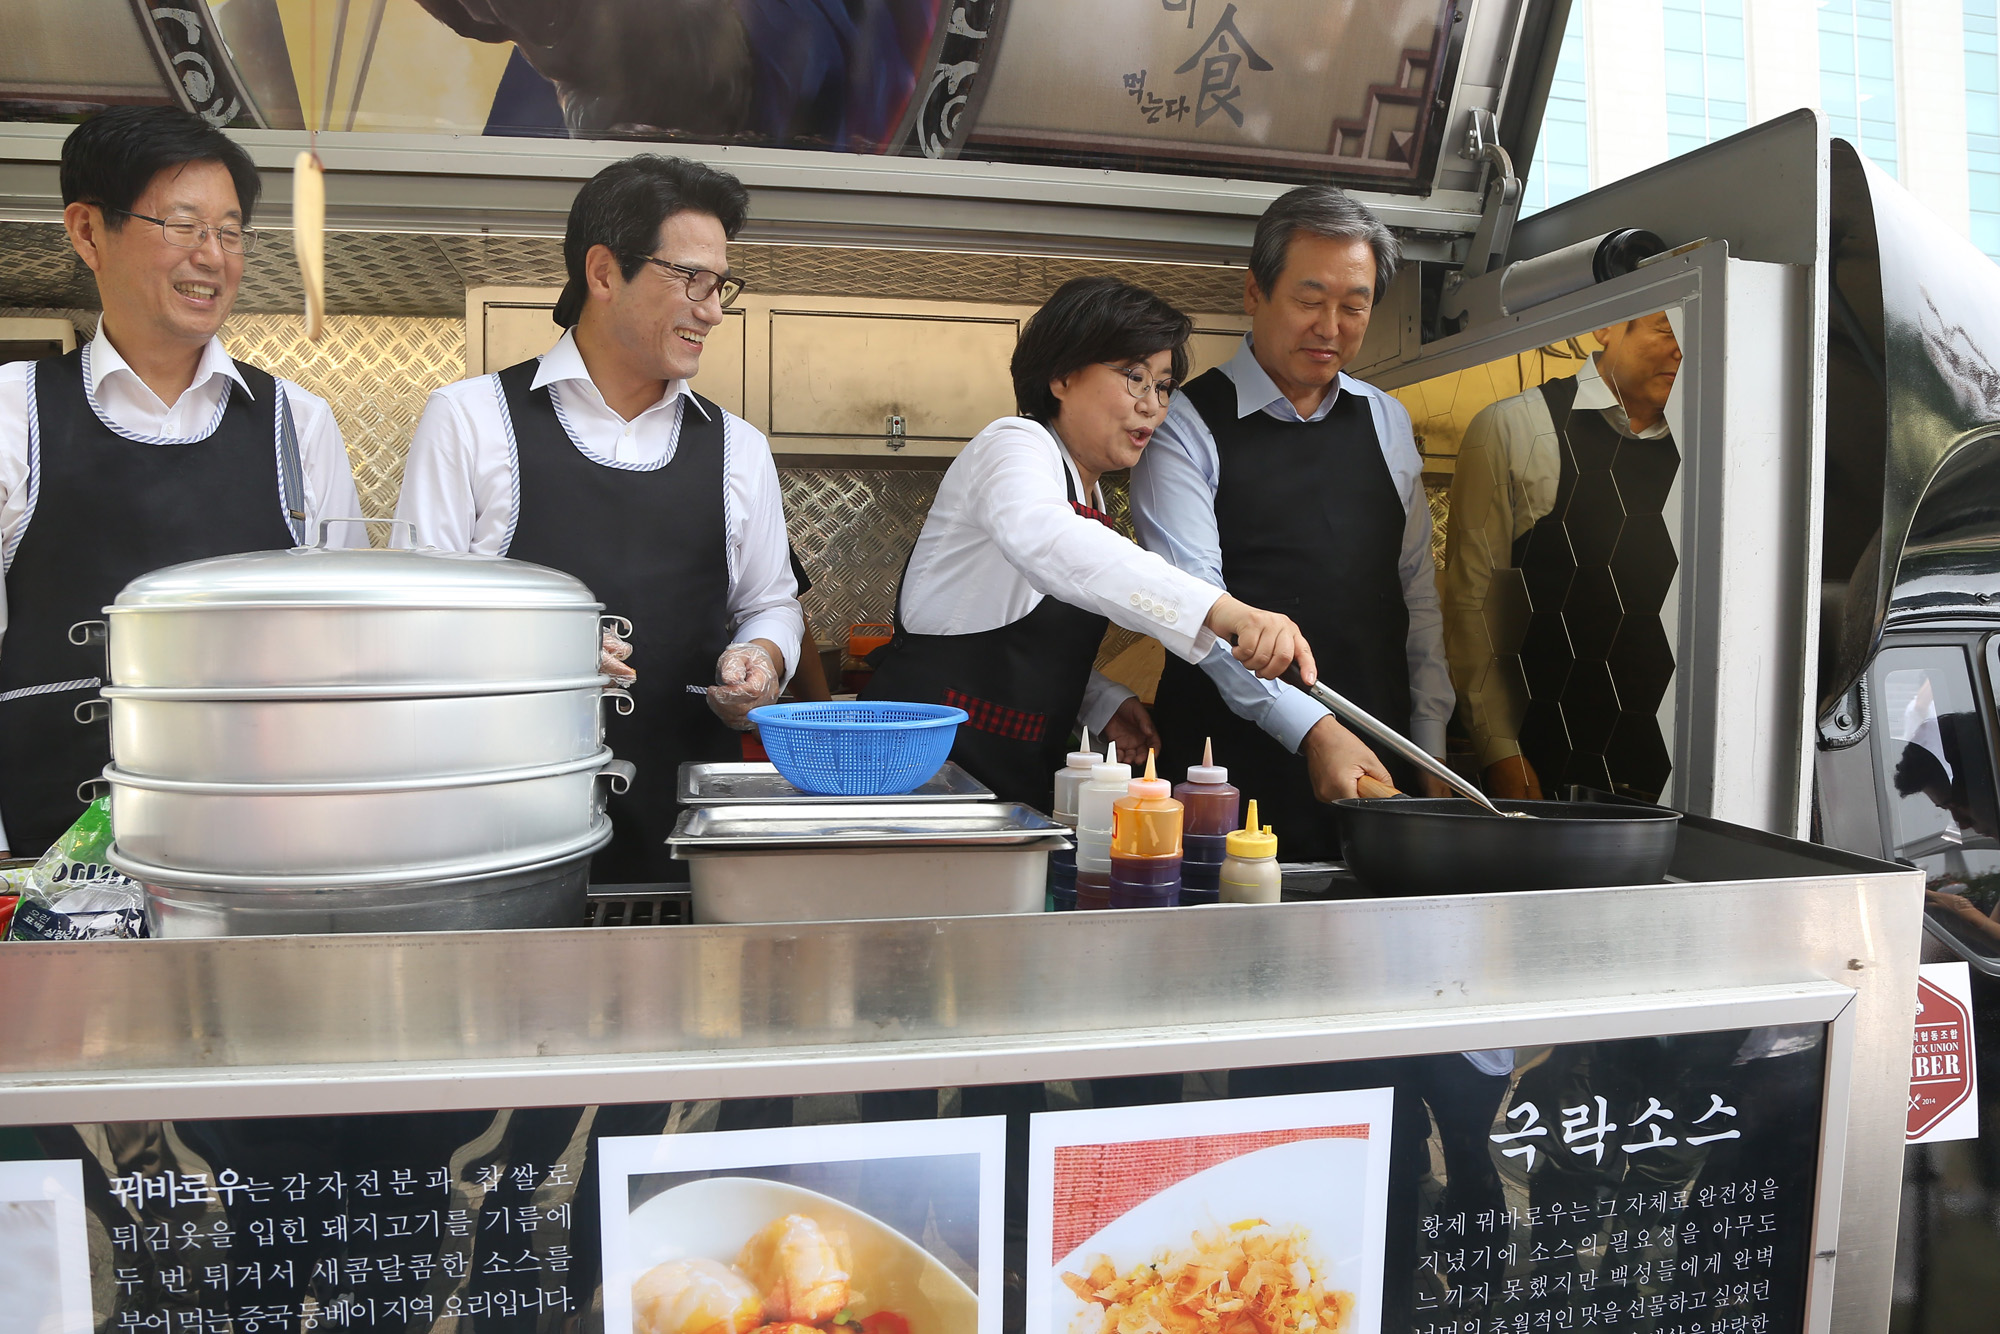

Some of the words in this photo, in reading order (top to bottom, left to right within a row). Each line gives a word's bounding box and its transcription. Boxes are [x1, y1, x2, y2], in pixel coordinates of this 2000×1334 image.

[1174, 3, 1273, 128] 食
[1123, 69, 1190, 124] 먹는다
[1911, 1055, 1960, 1077] BER
[1913, 1044, 1928, 1054] CK
[1930, 1042, 1959, 1053] UNION
[1489, 1094, 1741, 1173] 극락소스
[109, 1168, 274, 1210] 꿔바로우는
[476, 1163, 573, 1192] 찹쌀로
[1421, 1212, 1467, 1239] 황제
[1475, 1201, 1590, 1233] 꿔바로우는
[1597, 1200, 1618, 1218] 그
[1625, 1190, 1690, 1216] 자체로
[1698, 1177, 1779, 1208] 완전성을
[112, 1220, 236, 1252] 튀김옷을
[250, 1217, 308, 1247] 입힌
[321, 1210, 473, 1243] 돼지고기를
[485, 1202, 571, 1234] 기름에
[1418, 1242, 1517, 1275] 지녔기에
[1529, 1233, 1597, 1262] 소스의
[1610, 1221, 1700, 1253] 필요성을
[1712, 1213, 1777, 1240] 아무도
[115, 1267, 144, 1295] 두
[160, 1265, 187, 1293] 번
[203, 1259, 294, 1292] 튀겨서
[312, 1251, 469, 1286] 새콤달콤한
[483, 1245, 573, 1274] 소스를
[1416, 1281, 1490, 1310] 느끼지
[1502, 1268, 1599, 1303] 못했지만
[1610, 1251, 1723, 1288] 백성들에게
[1732, 1245, 1774, 1271] 완벽
[118, 1308, 170, 1334] 부어
[178, 1307, 234, 1334] 먹는
[237, 1304, 293, 1333] 중국
[382, 1294, 433, 1324] 지역
[440, 1285, 576, 1319] 요리입니다.
[1489, 1306, 1573, 1334] 초월적인
[1581, 1301, 1621, 1328] 맛을
[1627, 1291, 1707, 1319] 선물하고
[1712, 1279, 1769, 1308] 싶었던
